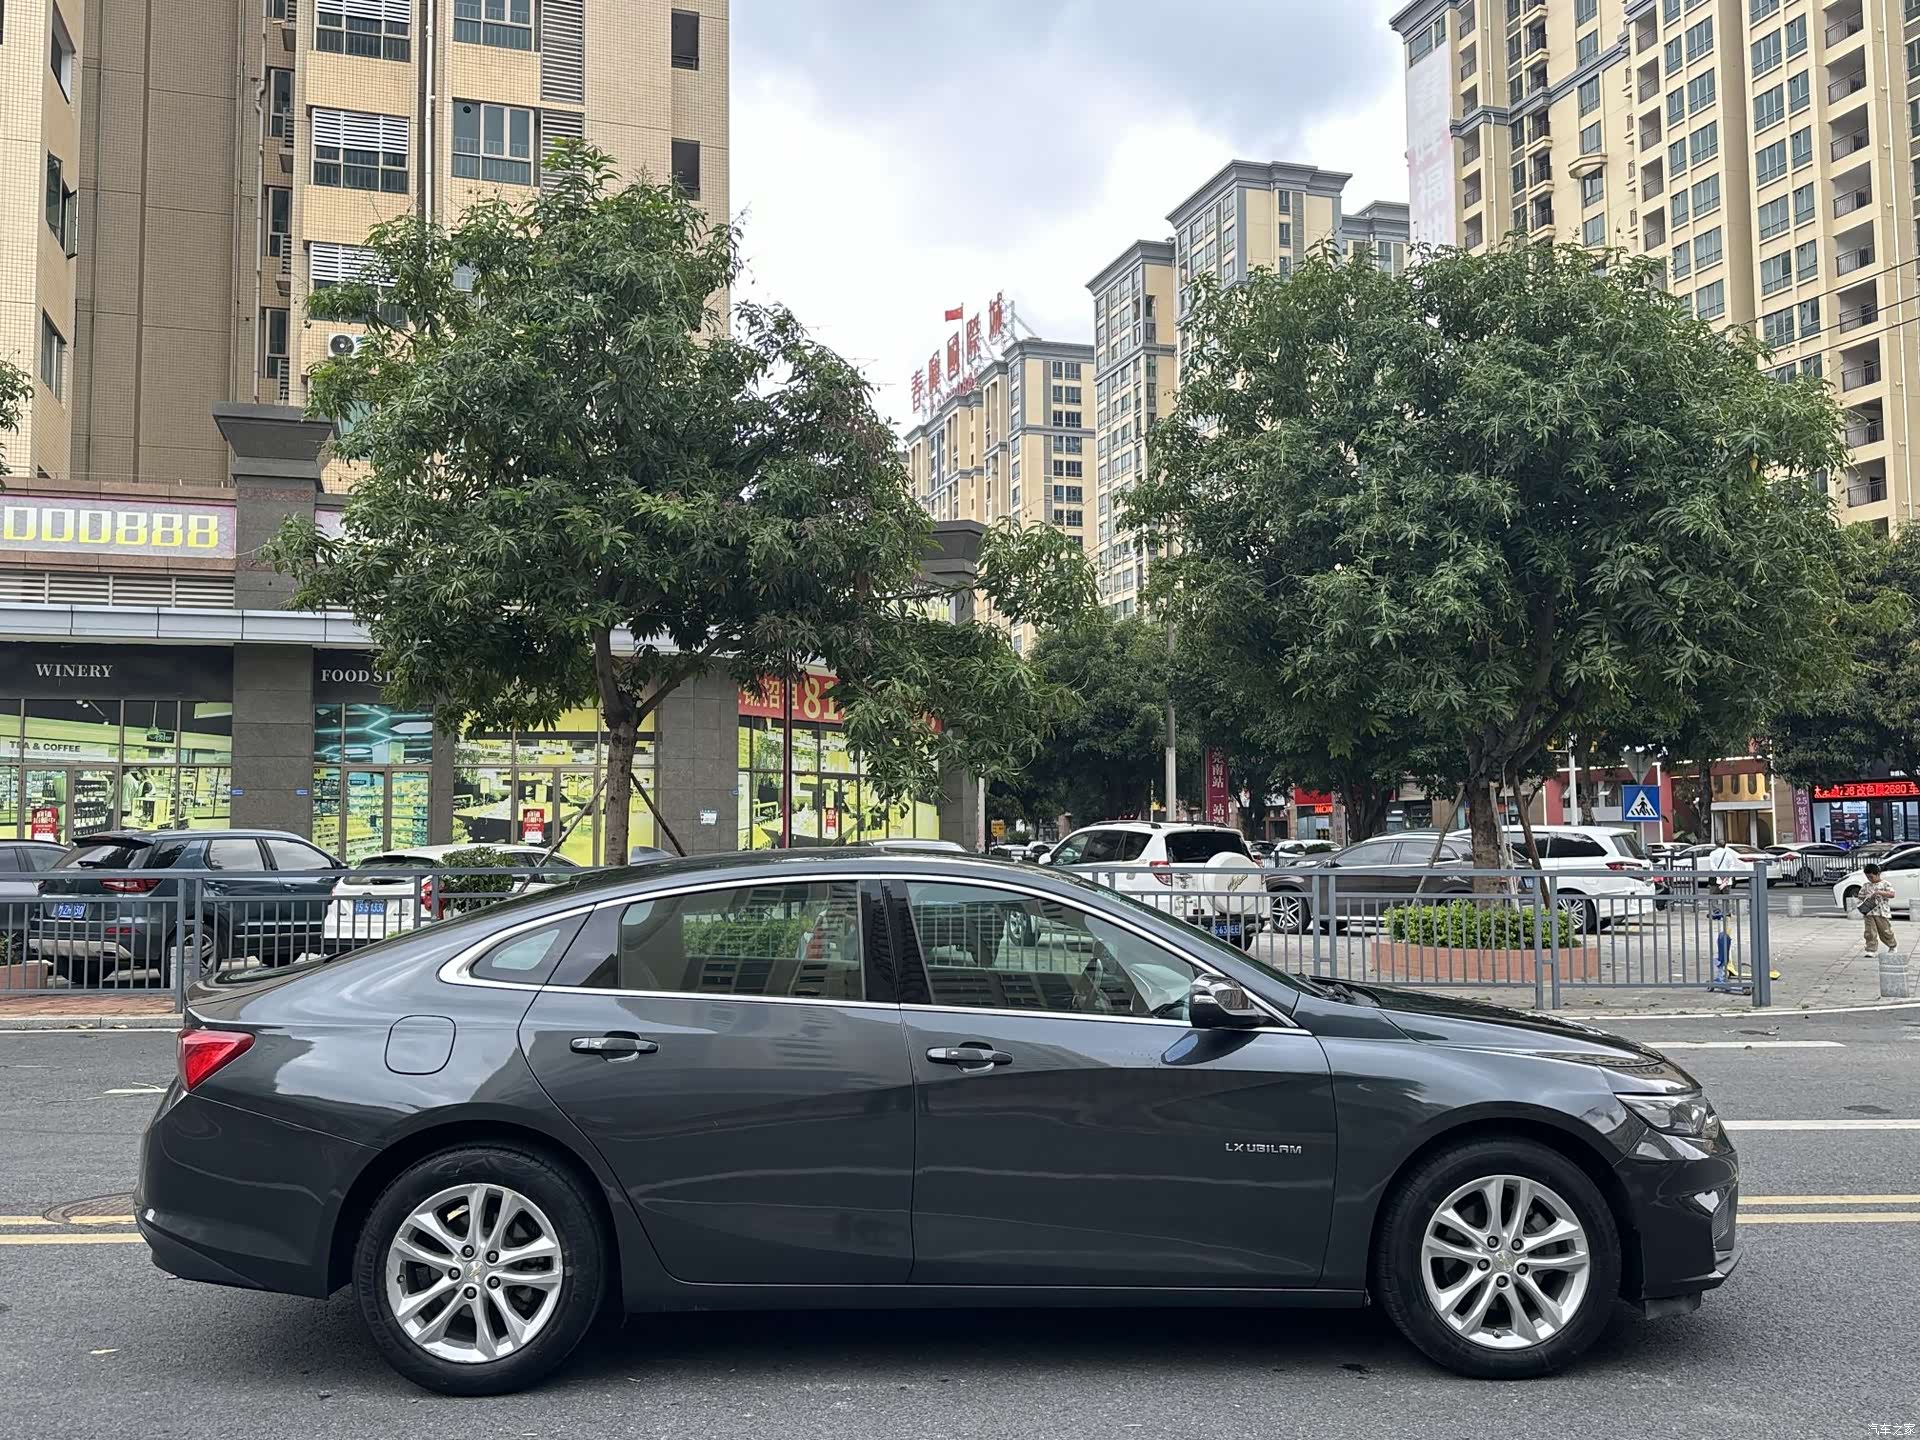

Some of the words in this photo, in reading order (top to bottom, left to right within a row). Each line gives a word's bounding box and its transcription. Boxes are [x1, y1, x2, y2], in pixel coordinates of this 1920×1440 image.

[3, 506, 220, 549] 000888
[35, 663, 113, 678] WINERY
[321, 668, 370, 683] FOOD
[32, 743, 40, 751] &
[43, 743, 81, 753] COFFEE
